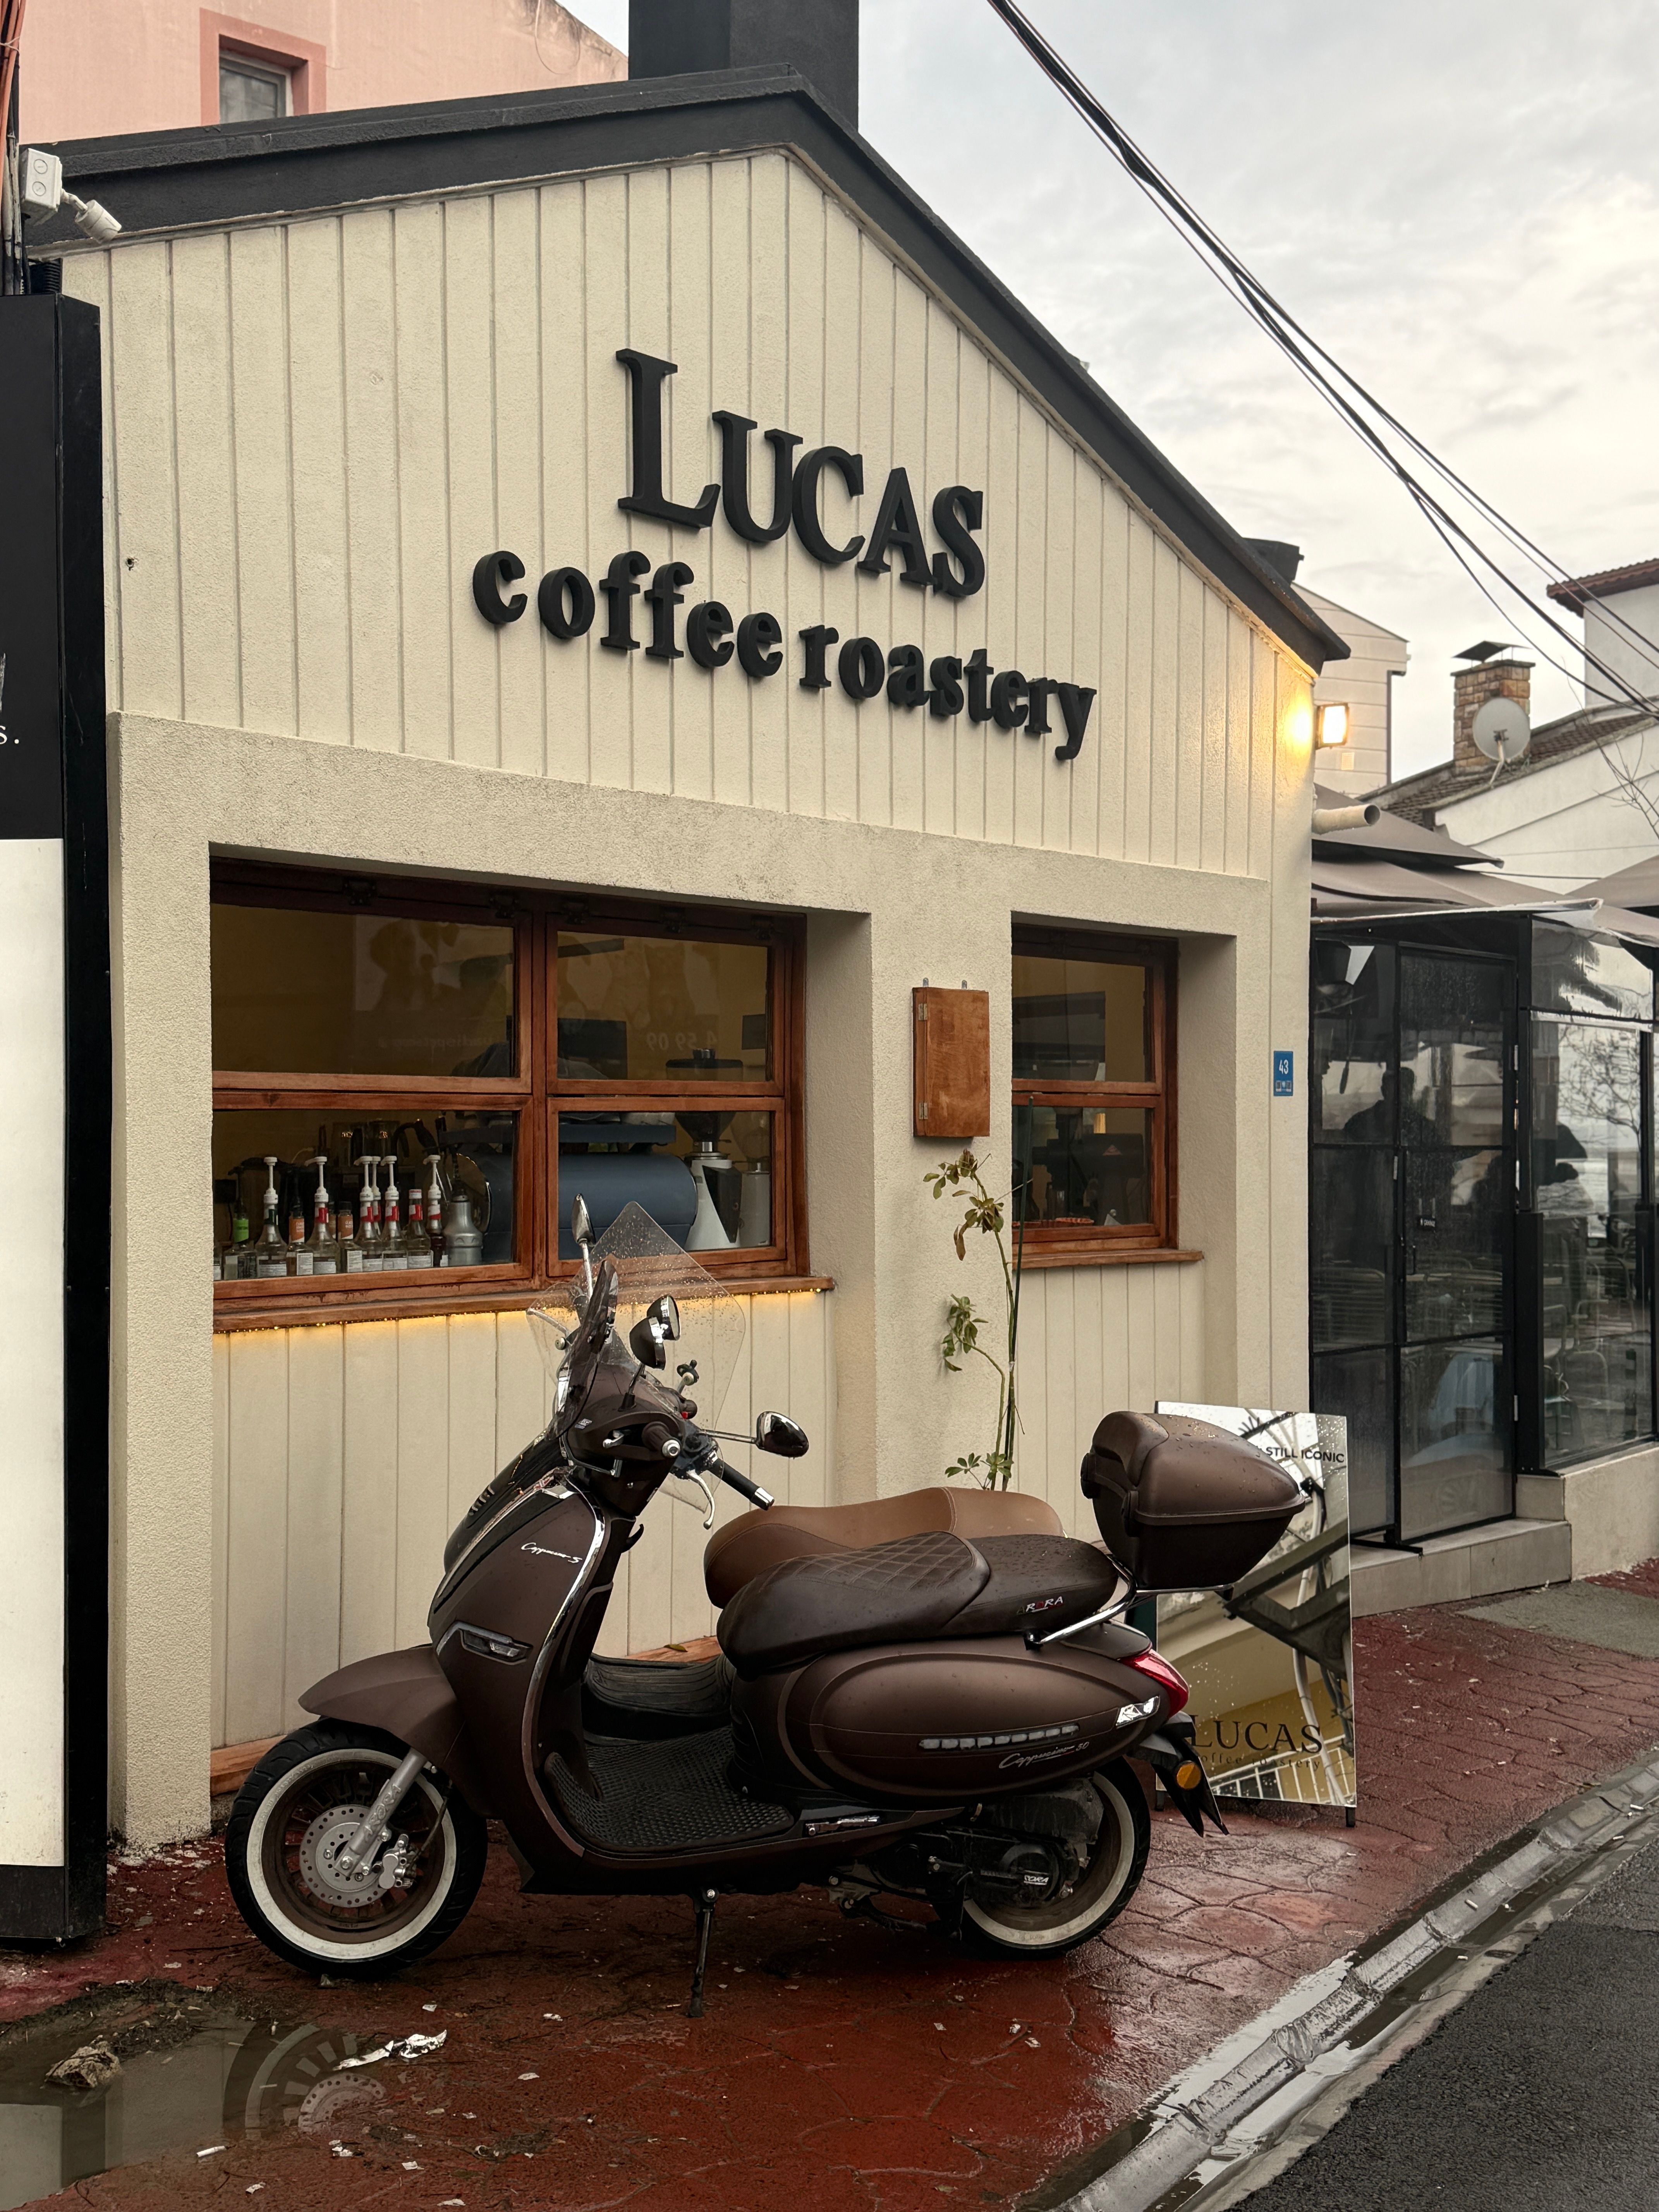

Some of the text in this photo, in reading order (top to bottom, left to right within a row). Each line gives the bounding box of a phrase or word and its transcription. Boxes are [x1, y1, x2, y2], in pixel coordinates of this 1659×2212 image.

[616, 348, 985, 599] LUCAS
[473, 551, 1097, 761] coffee roastery
[1279, 1059, 1289, 1075] 43
[1266, 1446, 1345, 1463] STILL ICONIC
[1189, 1714, 1322, 1754] LUCAS
[1076, 1741, 1090, 1752] 50
[1200, 1752, 1320, 1771] offee rostery
